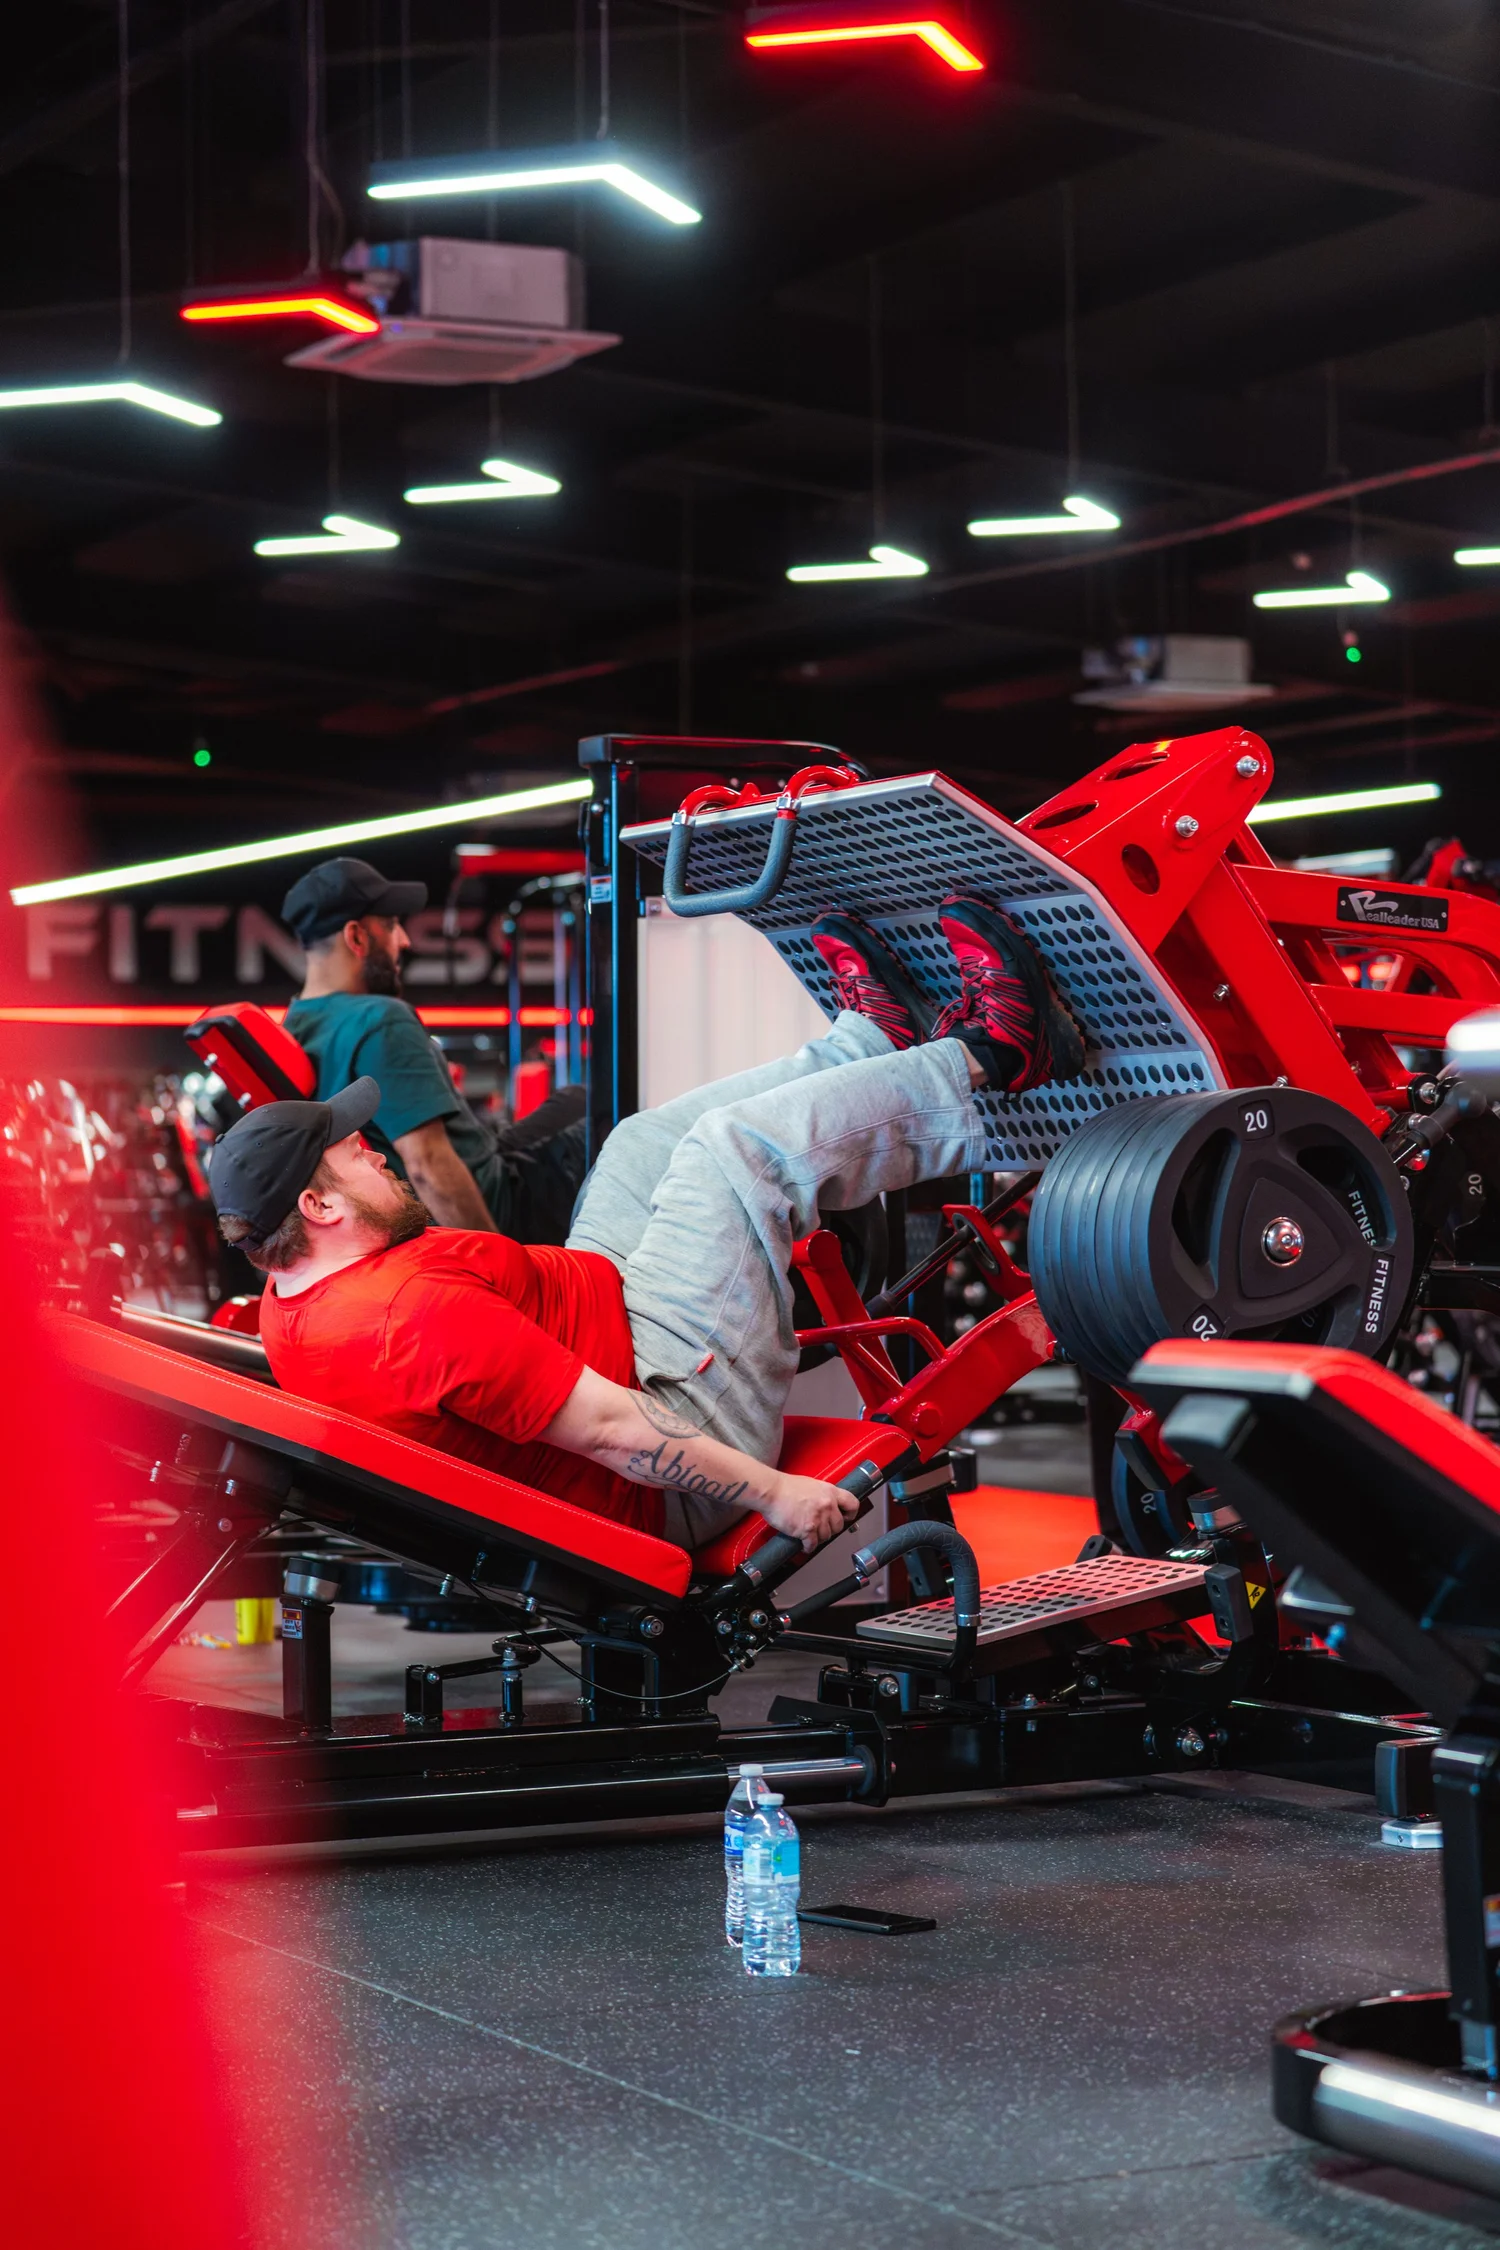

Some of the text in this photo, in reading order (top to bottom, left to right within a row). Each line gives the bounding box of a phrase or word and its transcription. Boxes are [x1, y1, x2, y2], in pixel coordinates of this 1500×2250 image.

[1348, 891, 1440, 929] Realleader USA
[26, 905, 575, 985] FITNSS
[1245, 1109, 1268, 1132] 20
[1468, 1173, 1482, 1195] 20
[1365, 1258, 1389, 1334] FITNESS
[1192, 1315, 1218, 1342] 20
[628, 1440, 750, 1503] Abigail
[1140, 1492, 1157, 1514] 20
